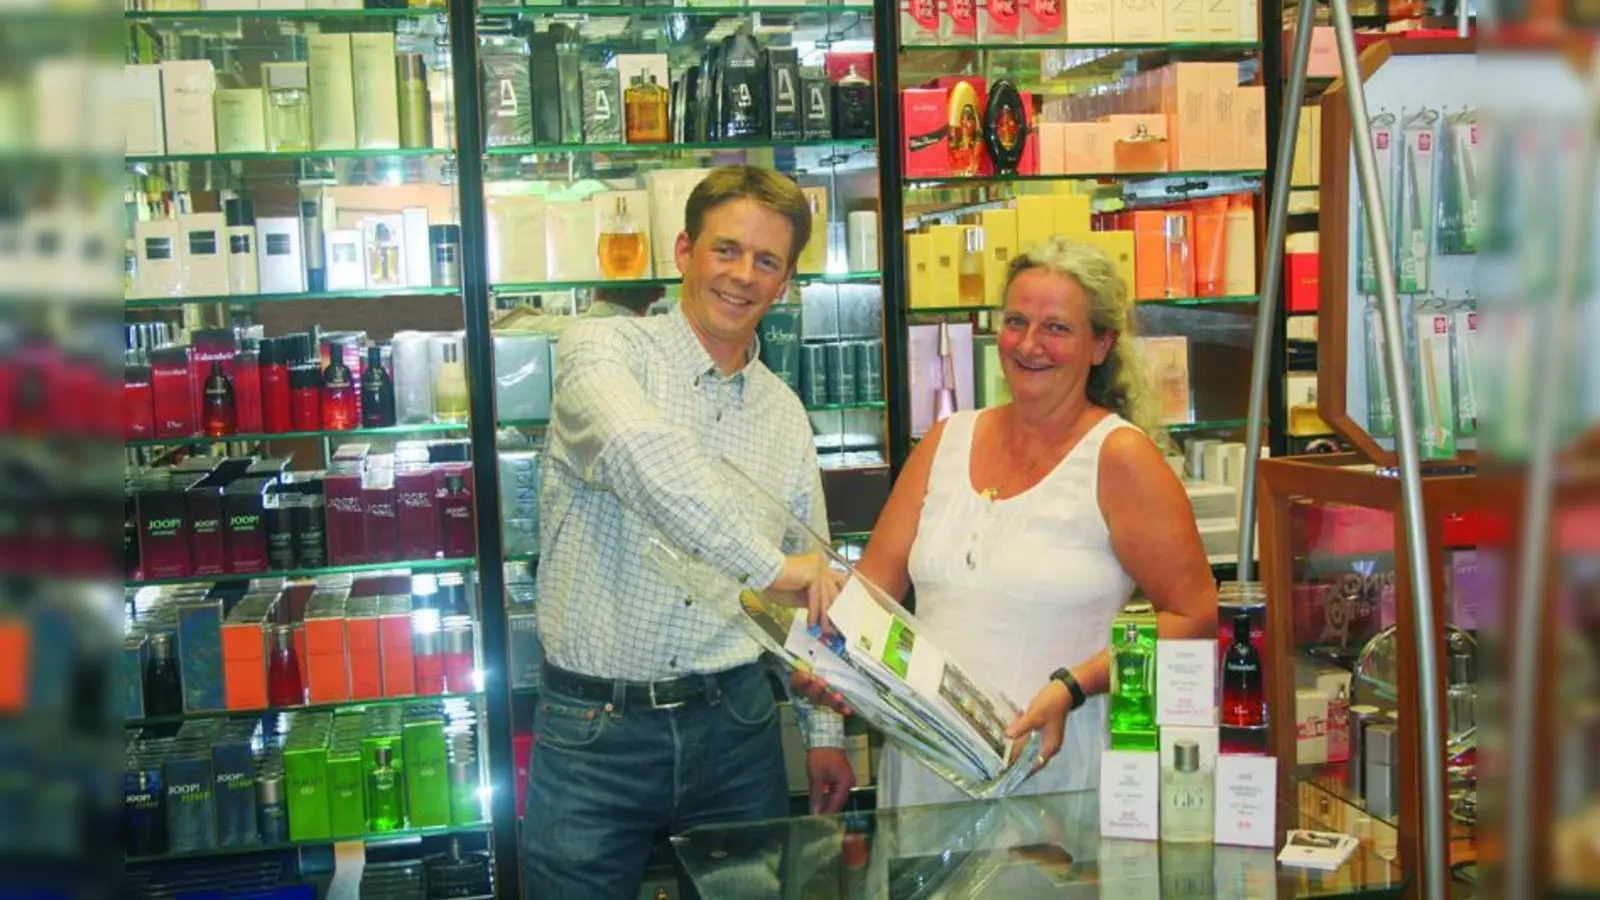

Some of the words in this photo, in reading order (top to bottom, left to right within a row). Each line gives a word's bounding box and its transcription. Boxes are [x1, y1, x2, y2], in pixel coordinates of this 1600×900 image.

[148, 519, 181, 530] JOOP!
[230, 515, 260, 525] JOOP!
[168, 783, 200, 795] JOOP!
